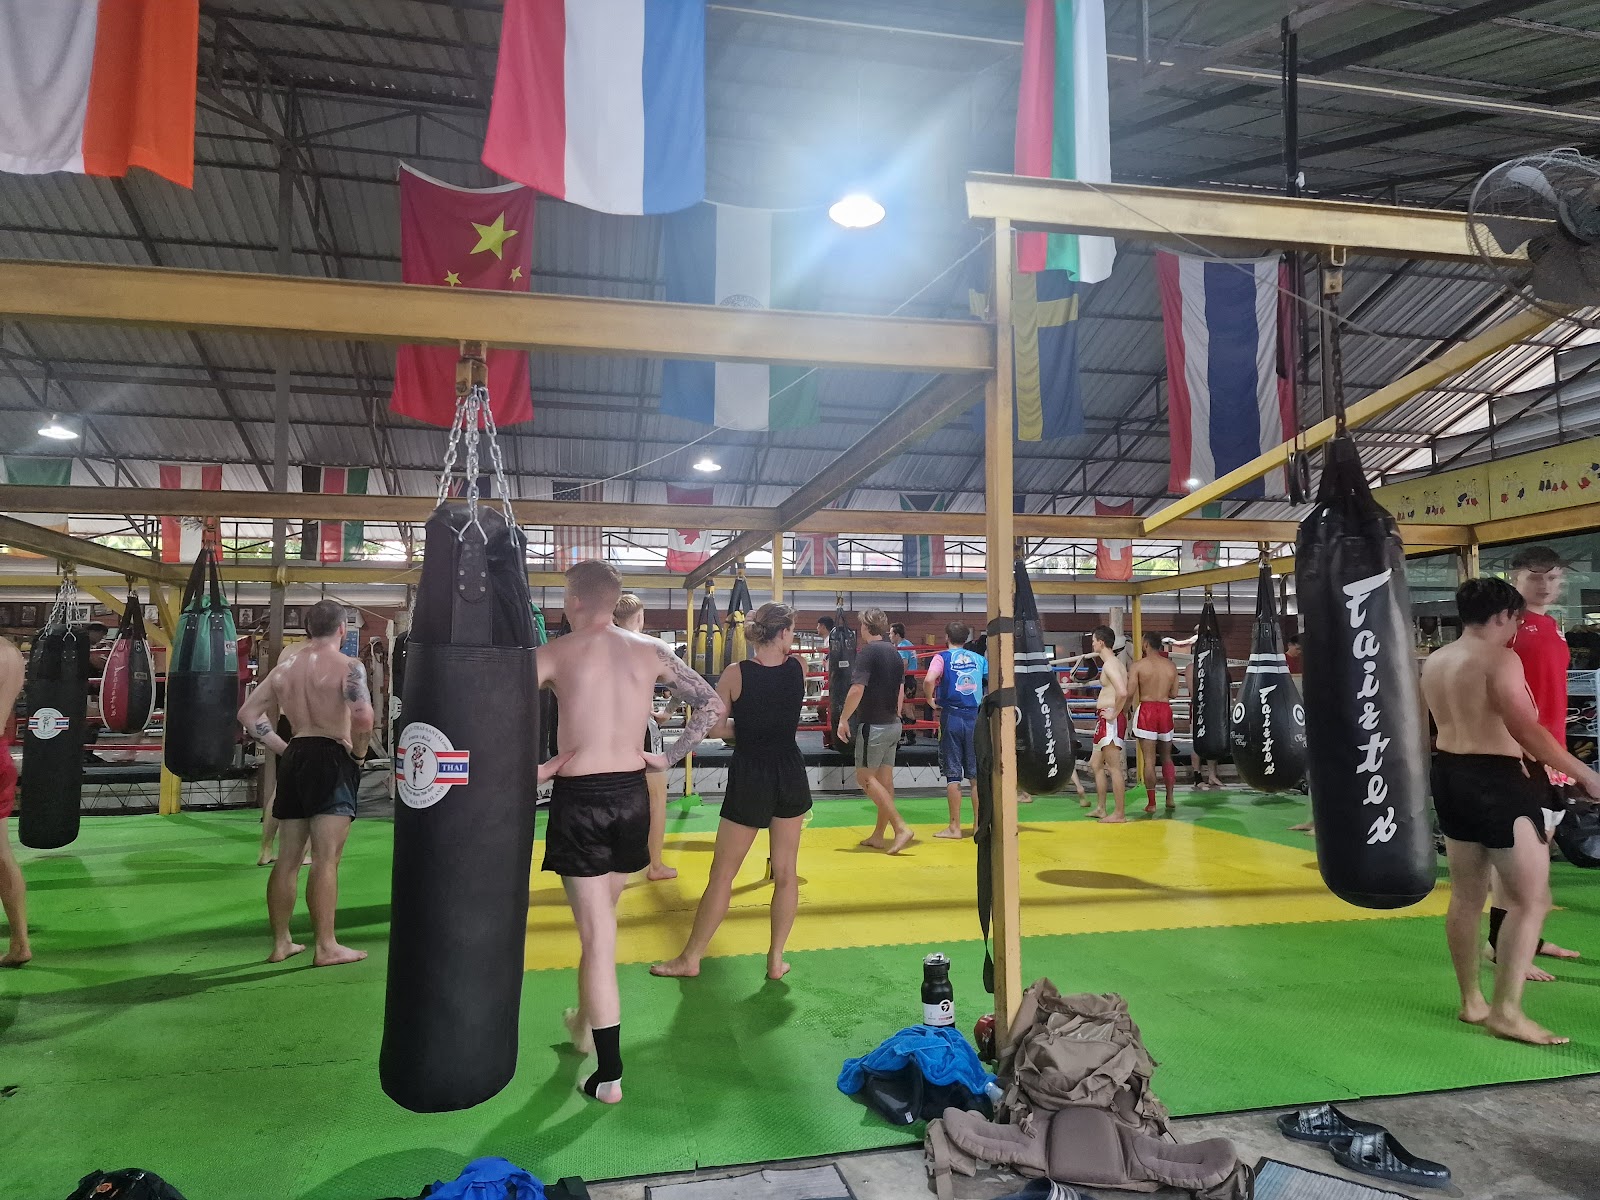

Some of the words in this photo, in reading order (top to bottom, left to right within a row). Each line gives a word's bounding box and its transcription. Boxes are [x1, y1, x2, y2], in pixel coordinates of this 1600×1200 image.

[1034, 682, 1058, 778] Fairtex
[1197, 650, 1211, 738] Fairtex
[1258, 684, 1278, 775] Fairtex
[1342, 568, 1398, 845] Fairtex
